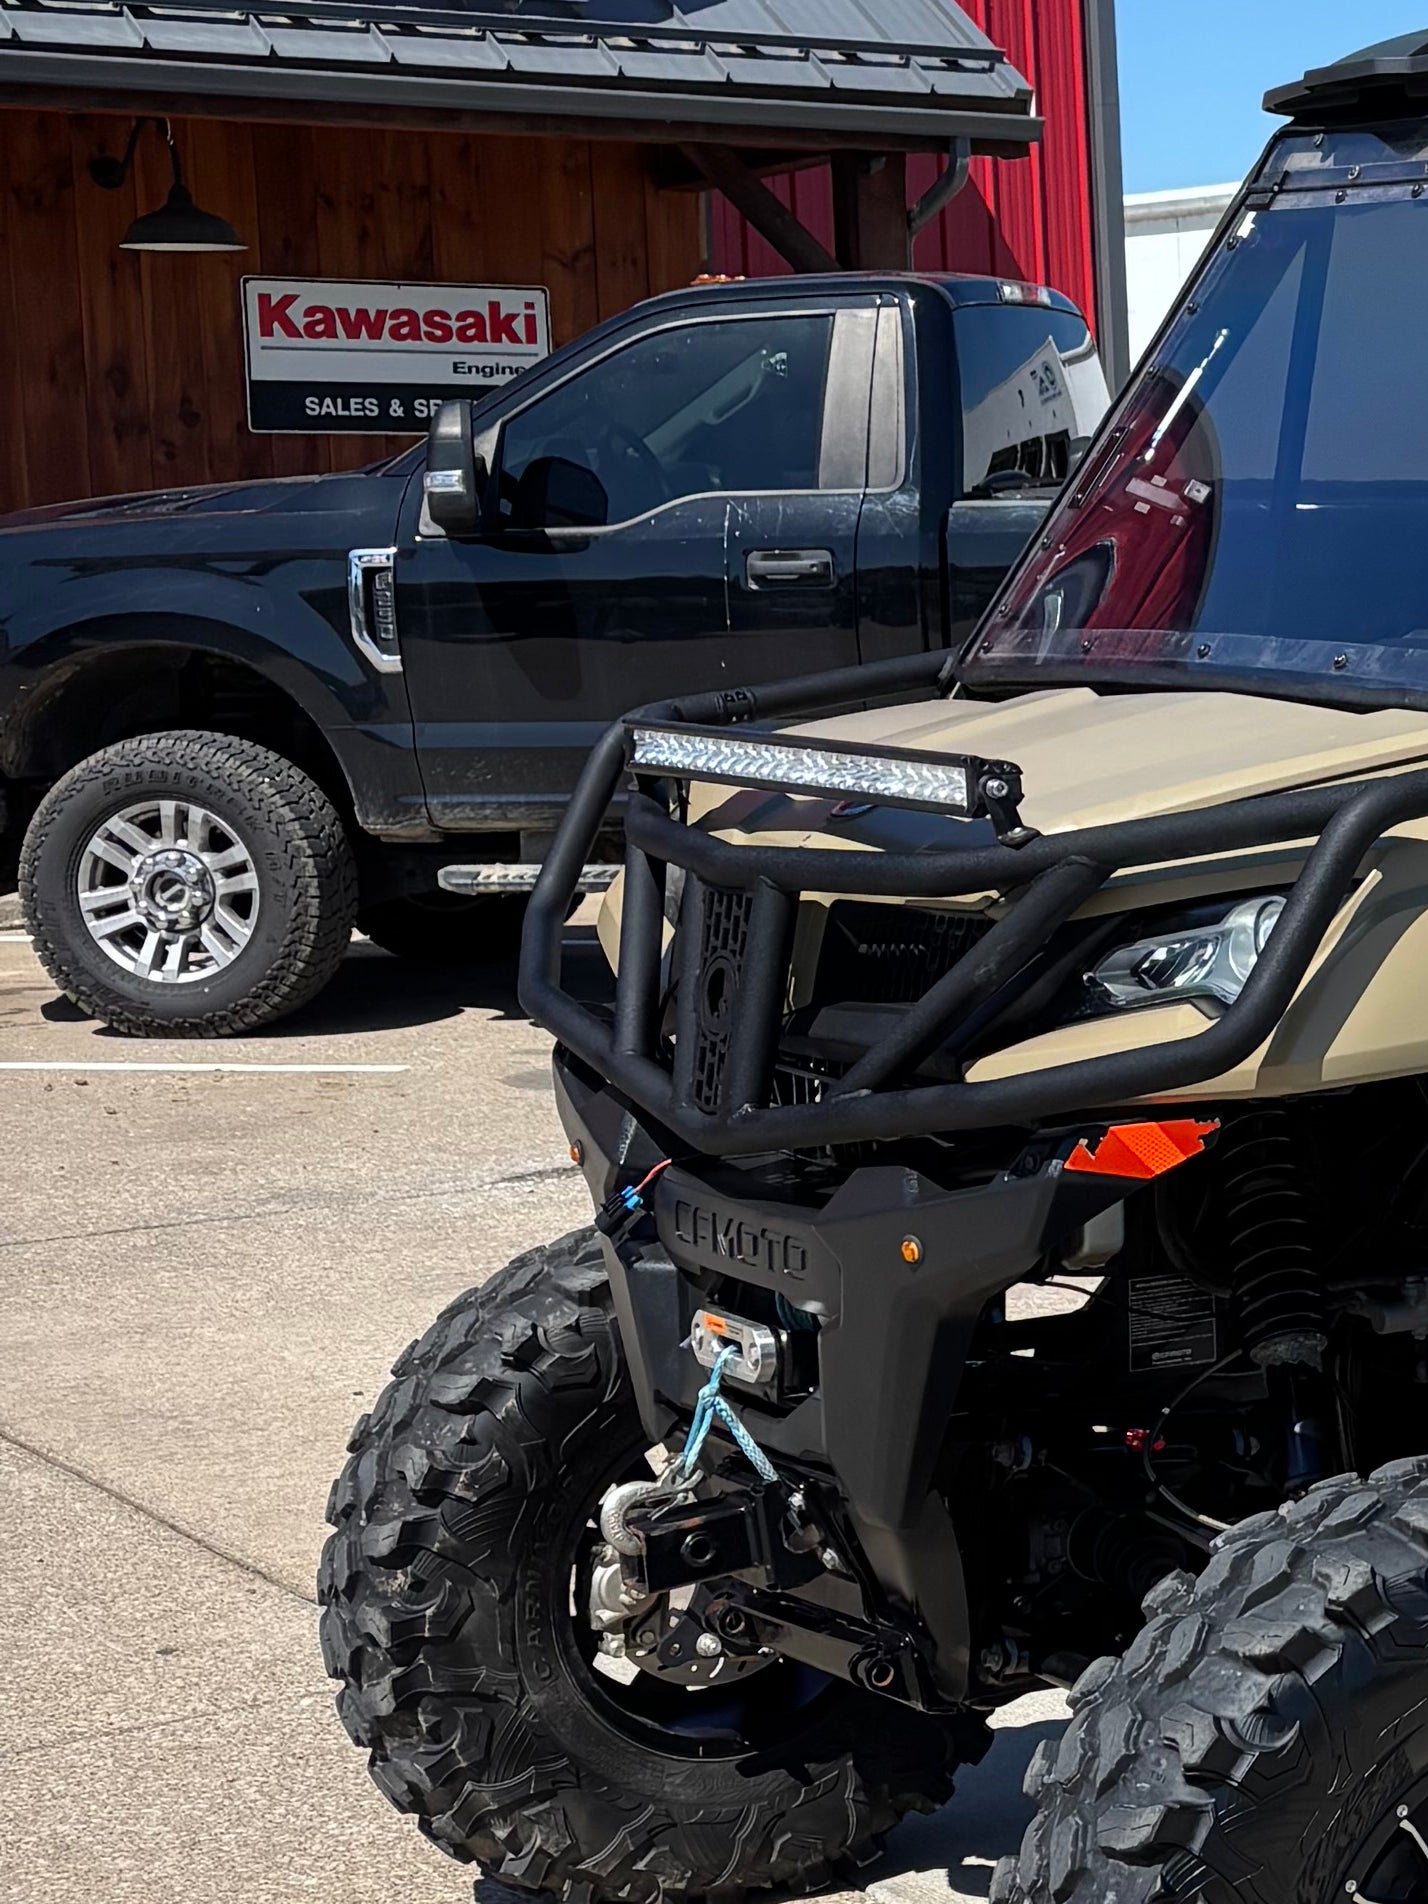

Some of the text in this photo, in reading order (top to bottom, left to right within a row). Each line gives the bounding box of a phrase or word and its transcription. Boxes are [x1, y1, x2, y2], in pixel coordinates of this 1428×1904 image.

[257, 293, 538, 345] Kawasaki
[305, 397, 379, 416] SALES
[389, 399, 404, 417] &
[675, 1200, 807, 1281] CFMOTO
